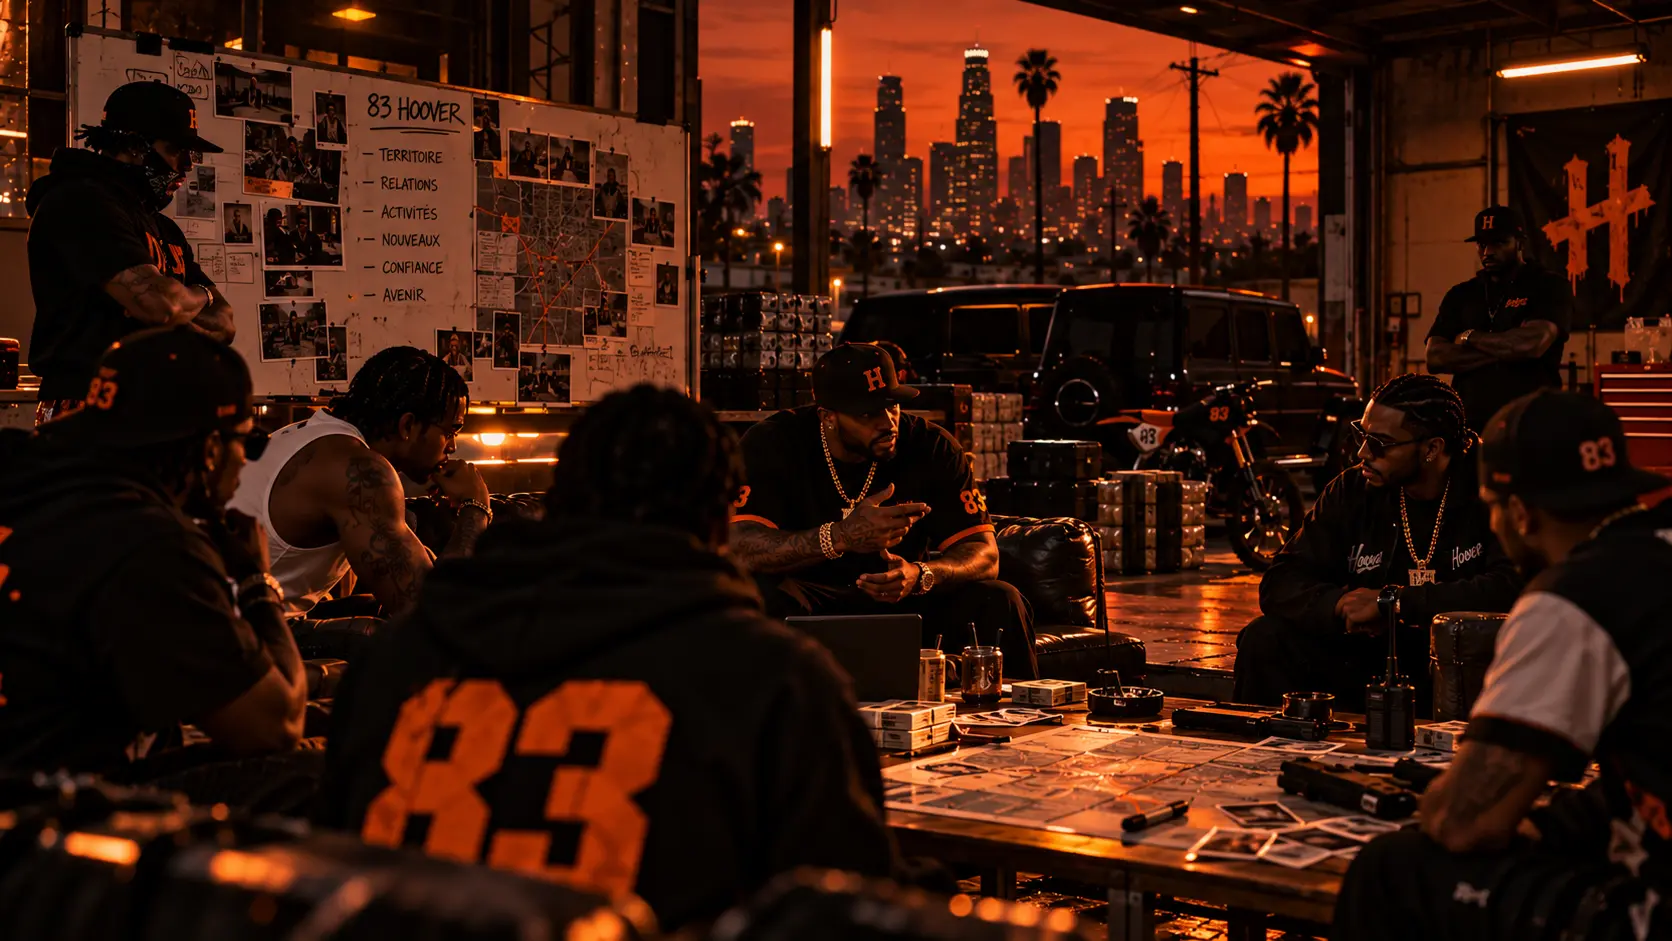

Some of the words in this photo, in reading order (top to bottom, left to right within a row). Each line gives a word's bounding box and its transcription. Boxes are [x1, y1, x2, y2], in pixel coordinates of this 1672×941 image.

[368, 92, 392, 118] 83
[398, 96, 466, 125] HOOVER
[379, 147, 443, 164] TERRITOIRE
[381, 175, 438, 192] RELATIONS
[1481, 215, 1495, 230] H
[382, 233, 440, 247] NOUVEAUX
[382, 260, 444, 274] CONFIANCE
[382, 287, 427, 302] AVENIR
[863, 366, 886, 393] H
[86, 376, 120, 411] 83
[1208, 405, 1231, 422] 83
[1578, 436, 1617, 472] 83
[960, 488, 988, 515] 83
[361, 676, 675, 895] 83
